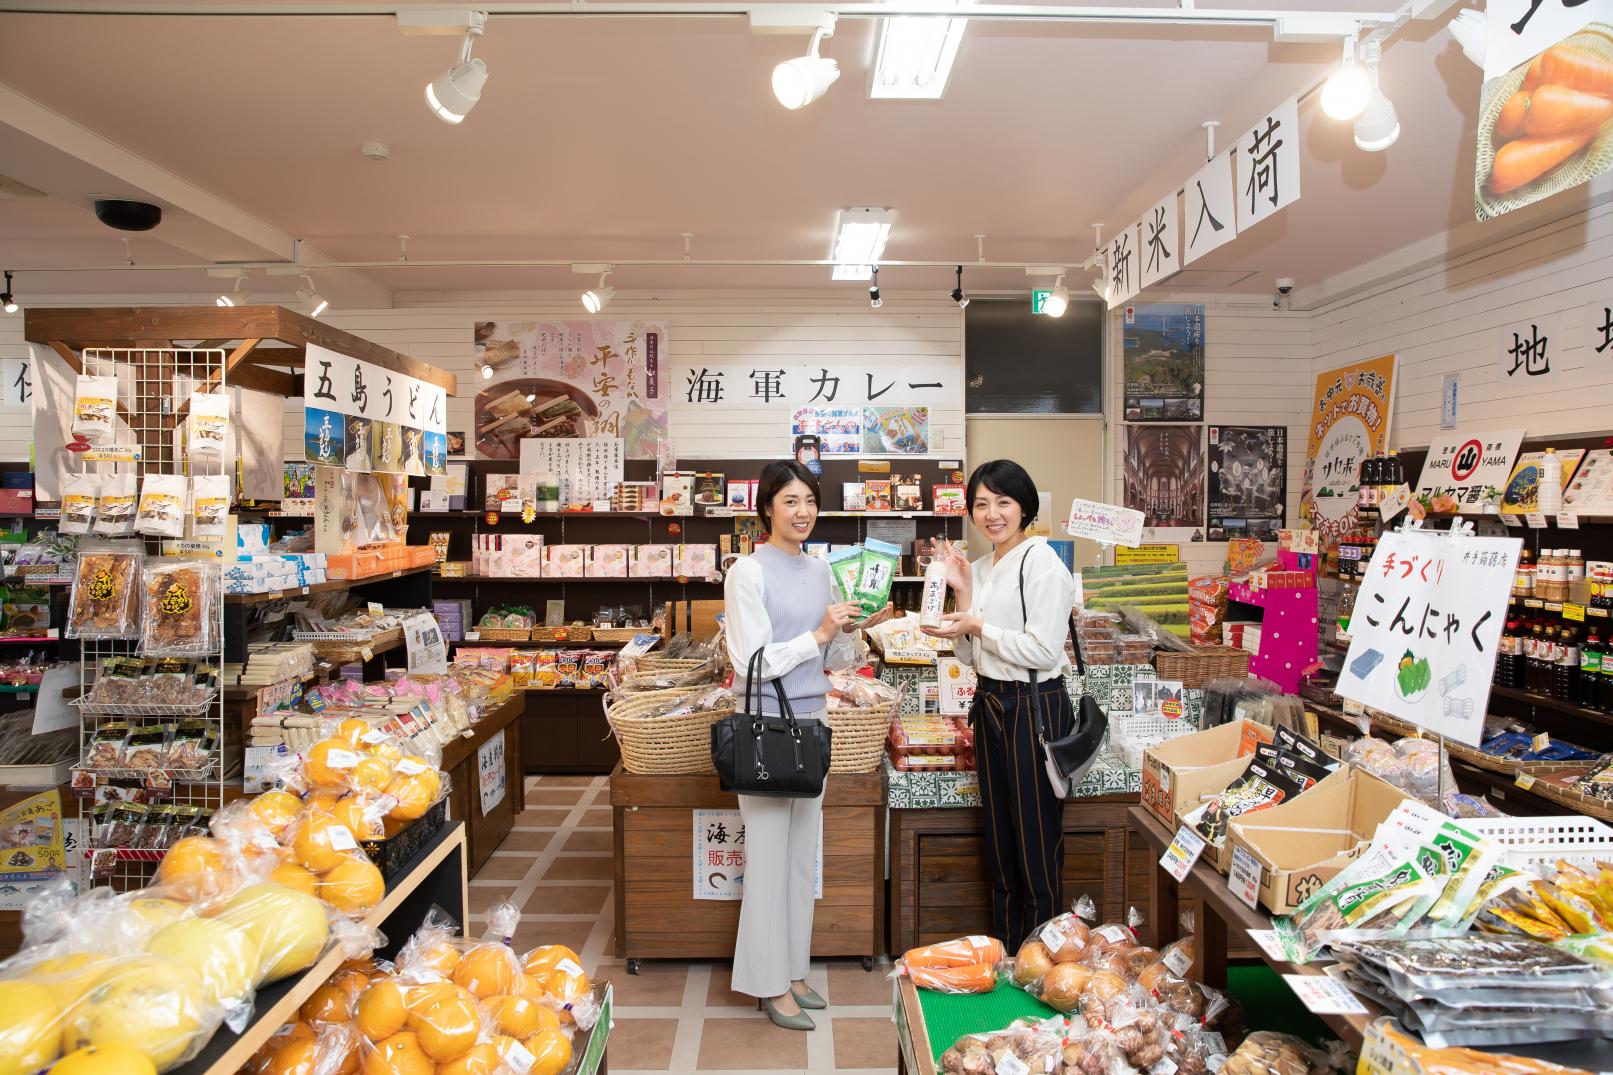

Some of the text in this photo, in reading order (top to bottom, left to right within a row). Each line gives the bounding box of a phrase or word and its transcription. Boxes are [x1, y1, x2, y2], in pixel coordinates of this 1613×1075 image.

[1113, 117, 1283, 296] 新米入荷
[314, 360, 442, 425] 五島うどん
[686, 368, 943, 403] 海軍カレー
[1429, 459, 1452, 469] MARU
[1481, 456, 1506, 466] YAMA
[1421, 484, 1486, 504] マルヤマ醤
[1382, 552, 1444, 586] 手づくり
[1366, 593, 1492, 653] こんにゃく
[708, 849, 746, 866] 販売
